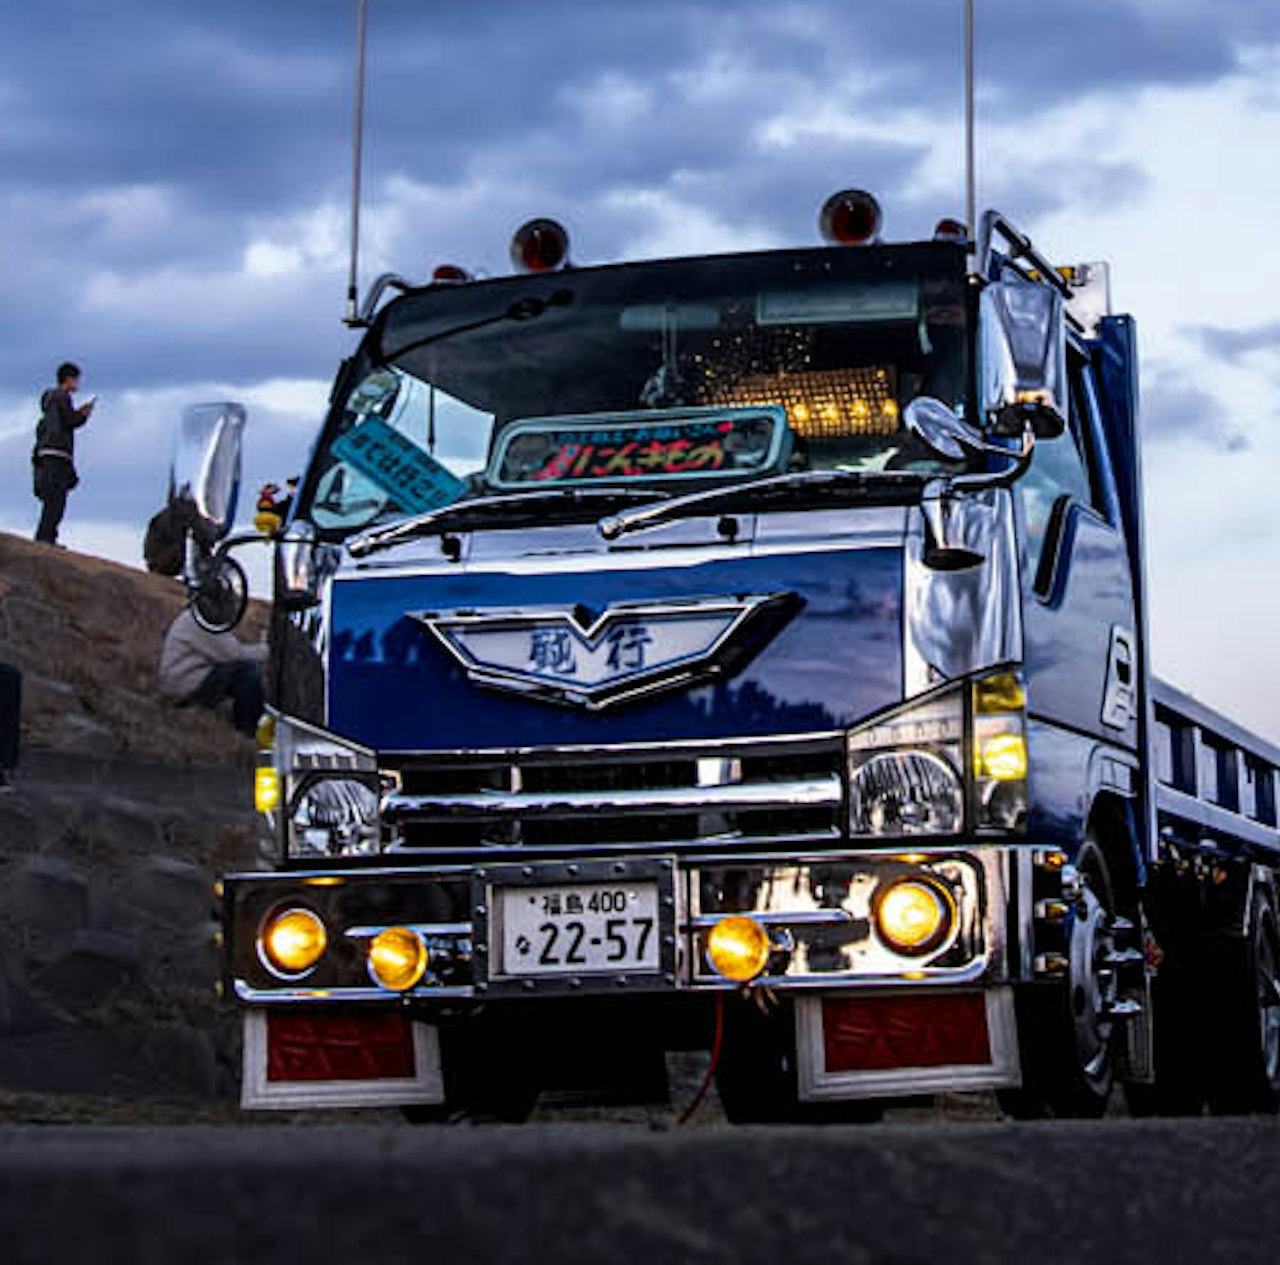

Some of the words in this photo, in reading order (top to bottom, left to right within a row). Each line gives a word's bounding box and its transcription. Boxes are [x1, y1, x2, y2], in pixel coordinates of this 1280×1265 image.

[543, 893, 583, 916] 福島
[588, 891, 626, 913] 400
[539, 918, 653, 965] 22-57
